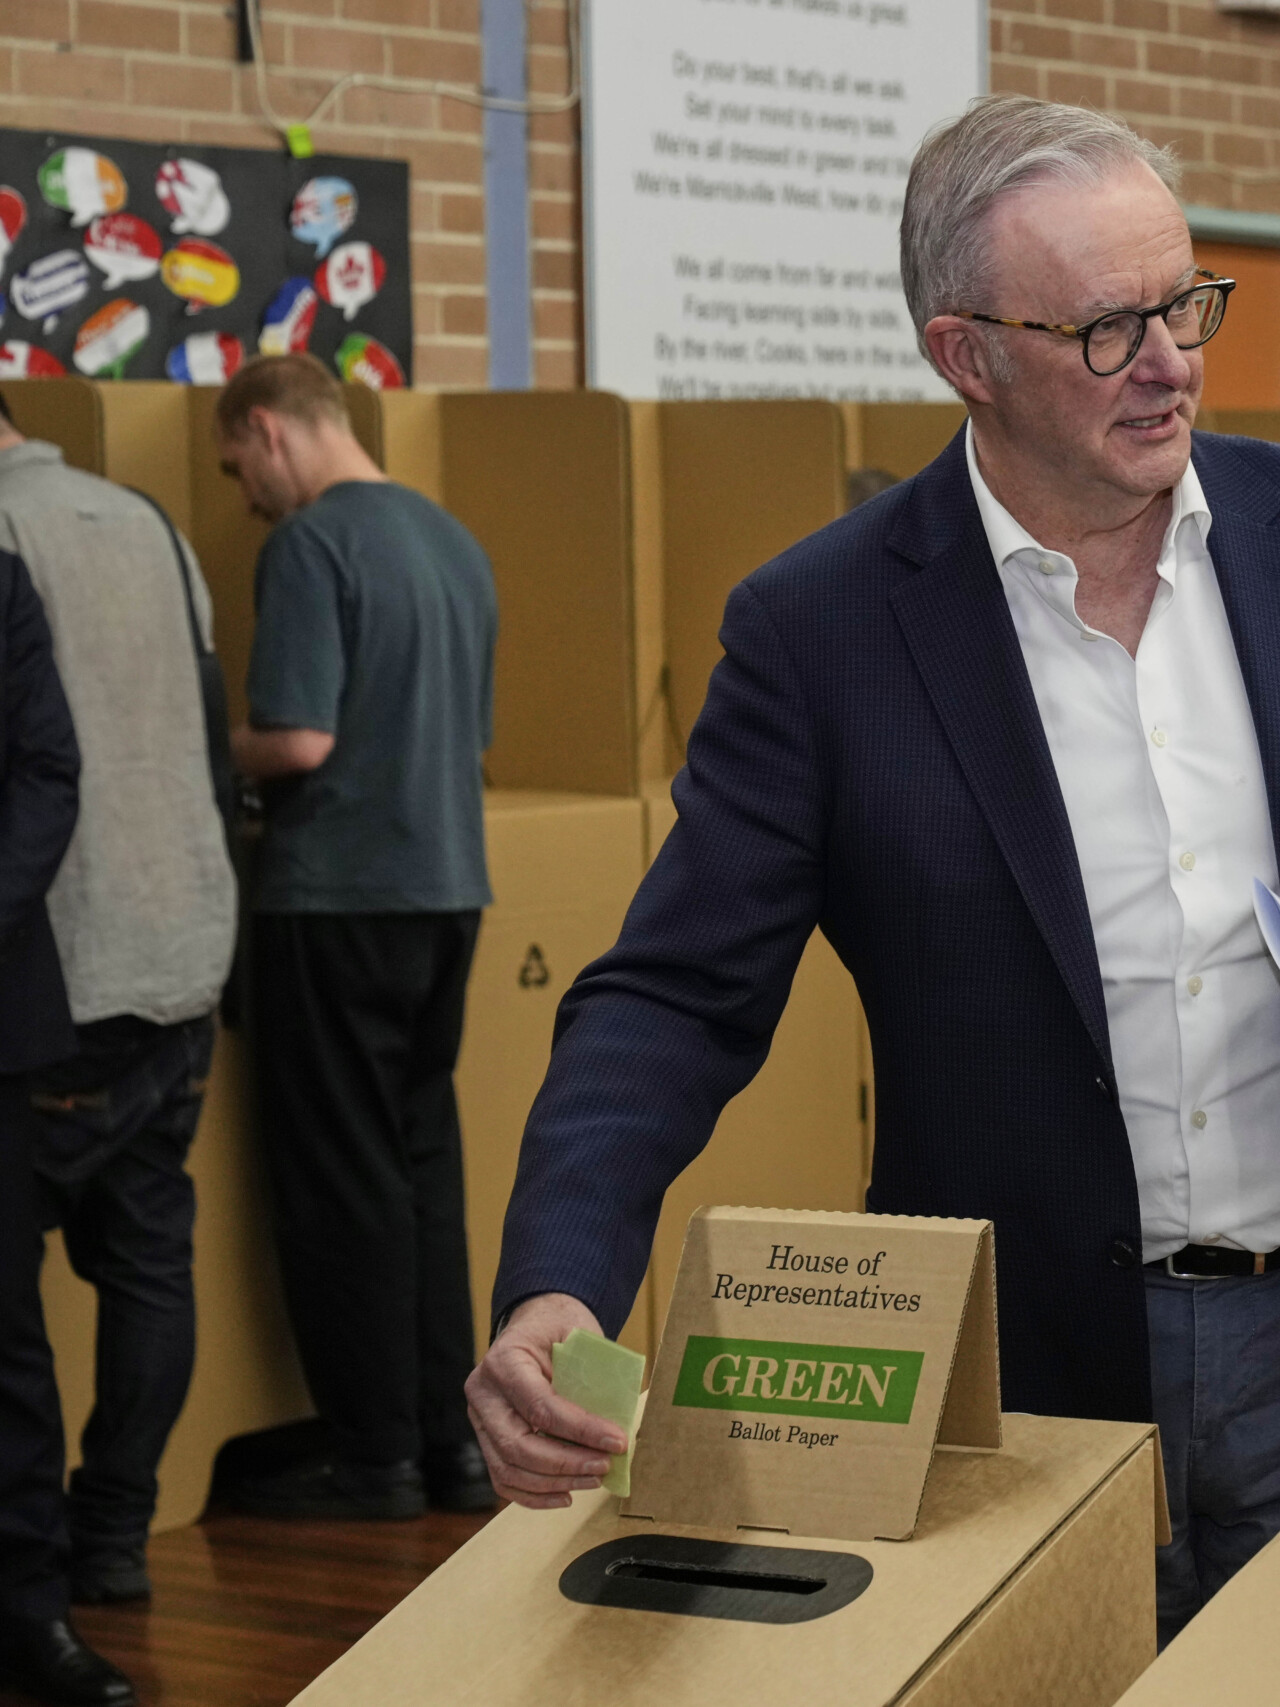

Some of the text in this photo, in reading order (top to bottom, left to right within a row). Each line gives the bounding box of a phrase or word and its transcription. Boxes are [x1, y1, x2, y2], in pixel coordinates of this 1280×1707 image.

[673, 51, 697, 78] Do
[703, 60, 737, 85] your
[685, 93, 712, 119] Set
[717, 101, 751, 126] your
[819, 114, 860, 138] every
[652, 132, 700, 158] We're
[706, 137, 723, 160] all
[815, 152, 857, 176] green
[634, 171, 682, 197] We're
[673, 255, 700, 280] We
[683, 294, 738, 328] Facing
[655, 334, 677, 365] By
[766, 1244, 887, 1278] House of
[711, 1274, 921, 1313] Representatives
[701, 1352, 898, 1409] GREEN
[728, 1420, 839, 1450] Ballot Paper
